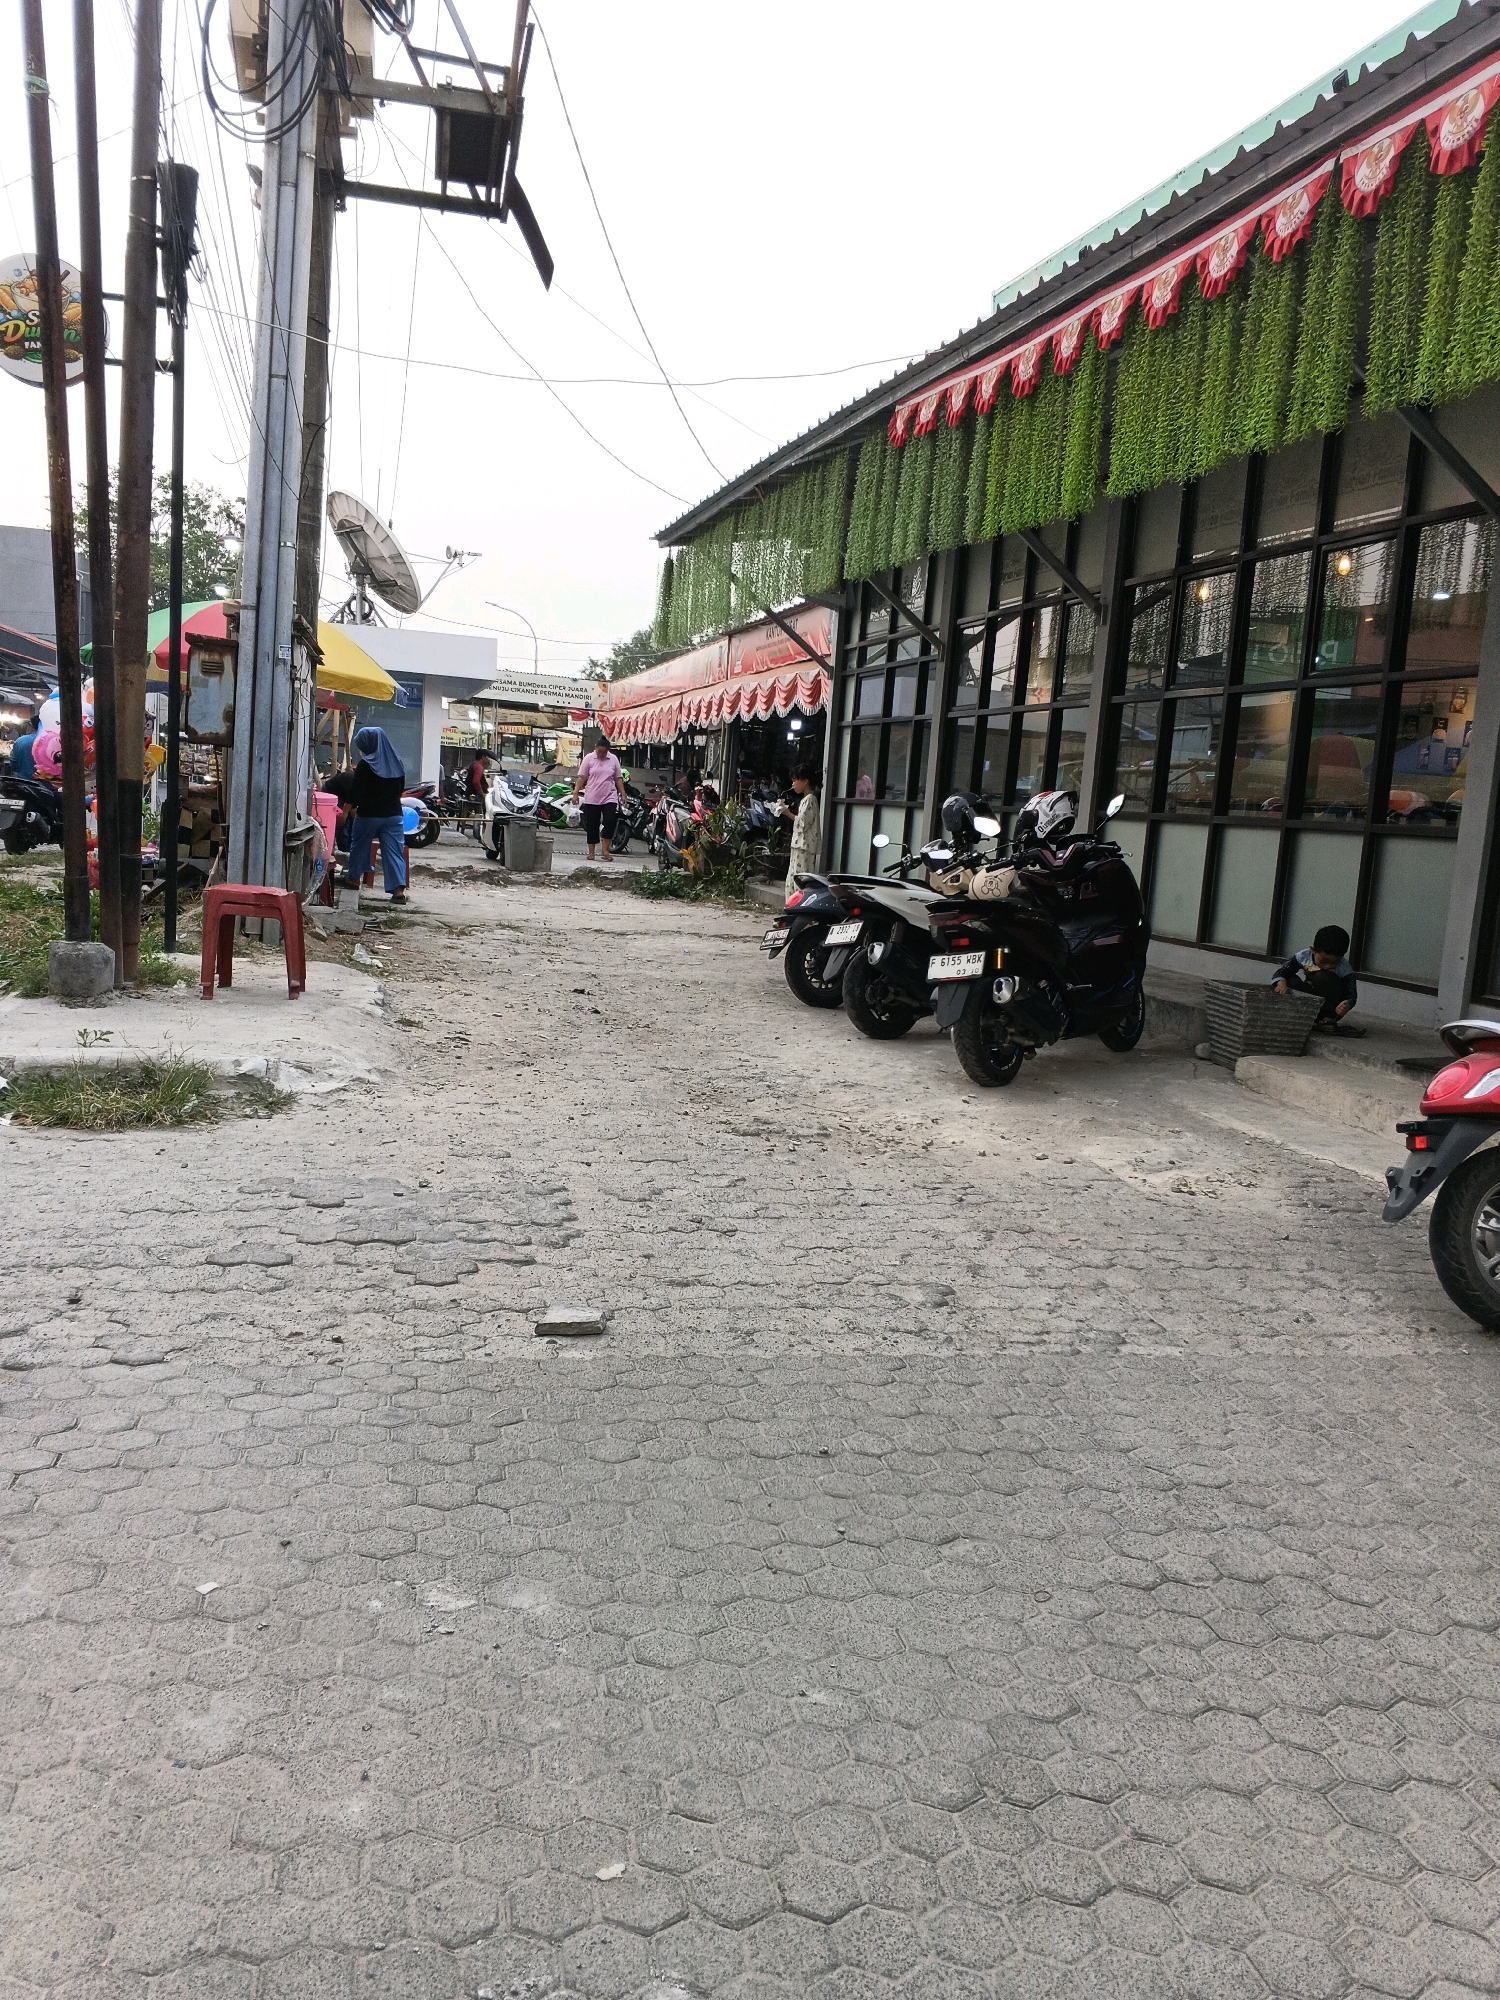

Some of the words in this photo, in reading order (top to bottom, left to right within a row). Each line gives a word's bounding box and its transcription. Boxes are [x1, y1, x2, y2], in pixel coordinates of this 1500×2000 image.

[0, 319, 81, 343] Dun
[510, 687, 539, 695] CIKANDE
[540, 690, 564, 698] PERMAI
[564, 692, 592, 701] MANDIRI
[930, 958, 936, 968] F
[940, 955, 962, 967] 6155
[966, 953, 983, 964] WBK
